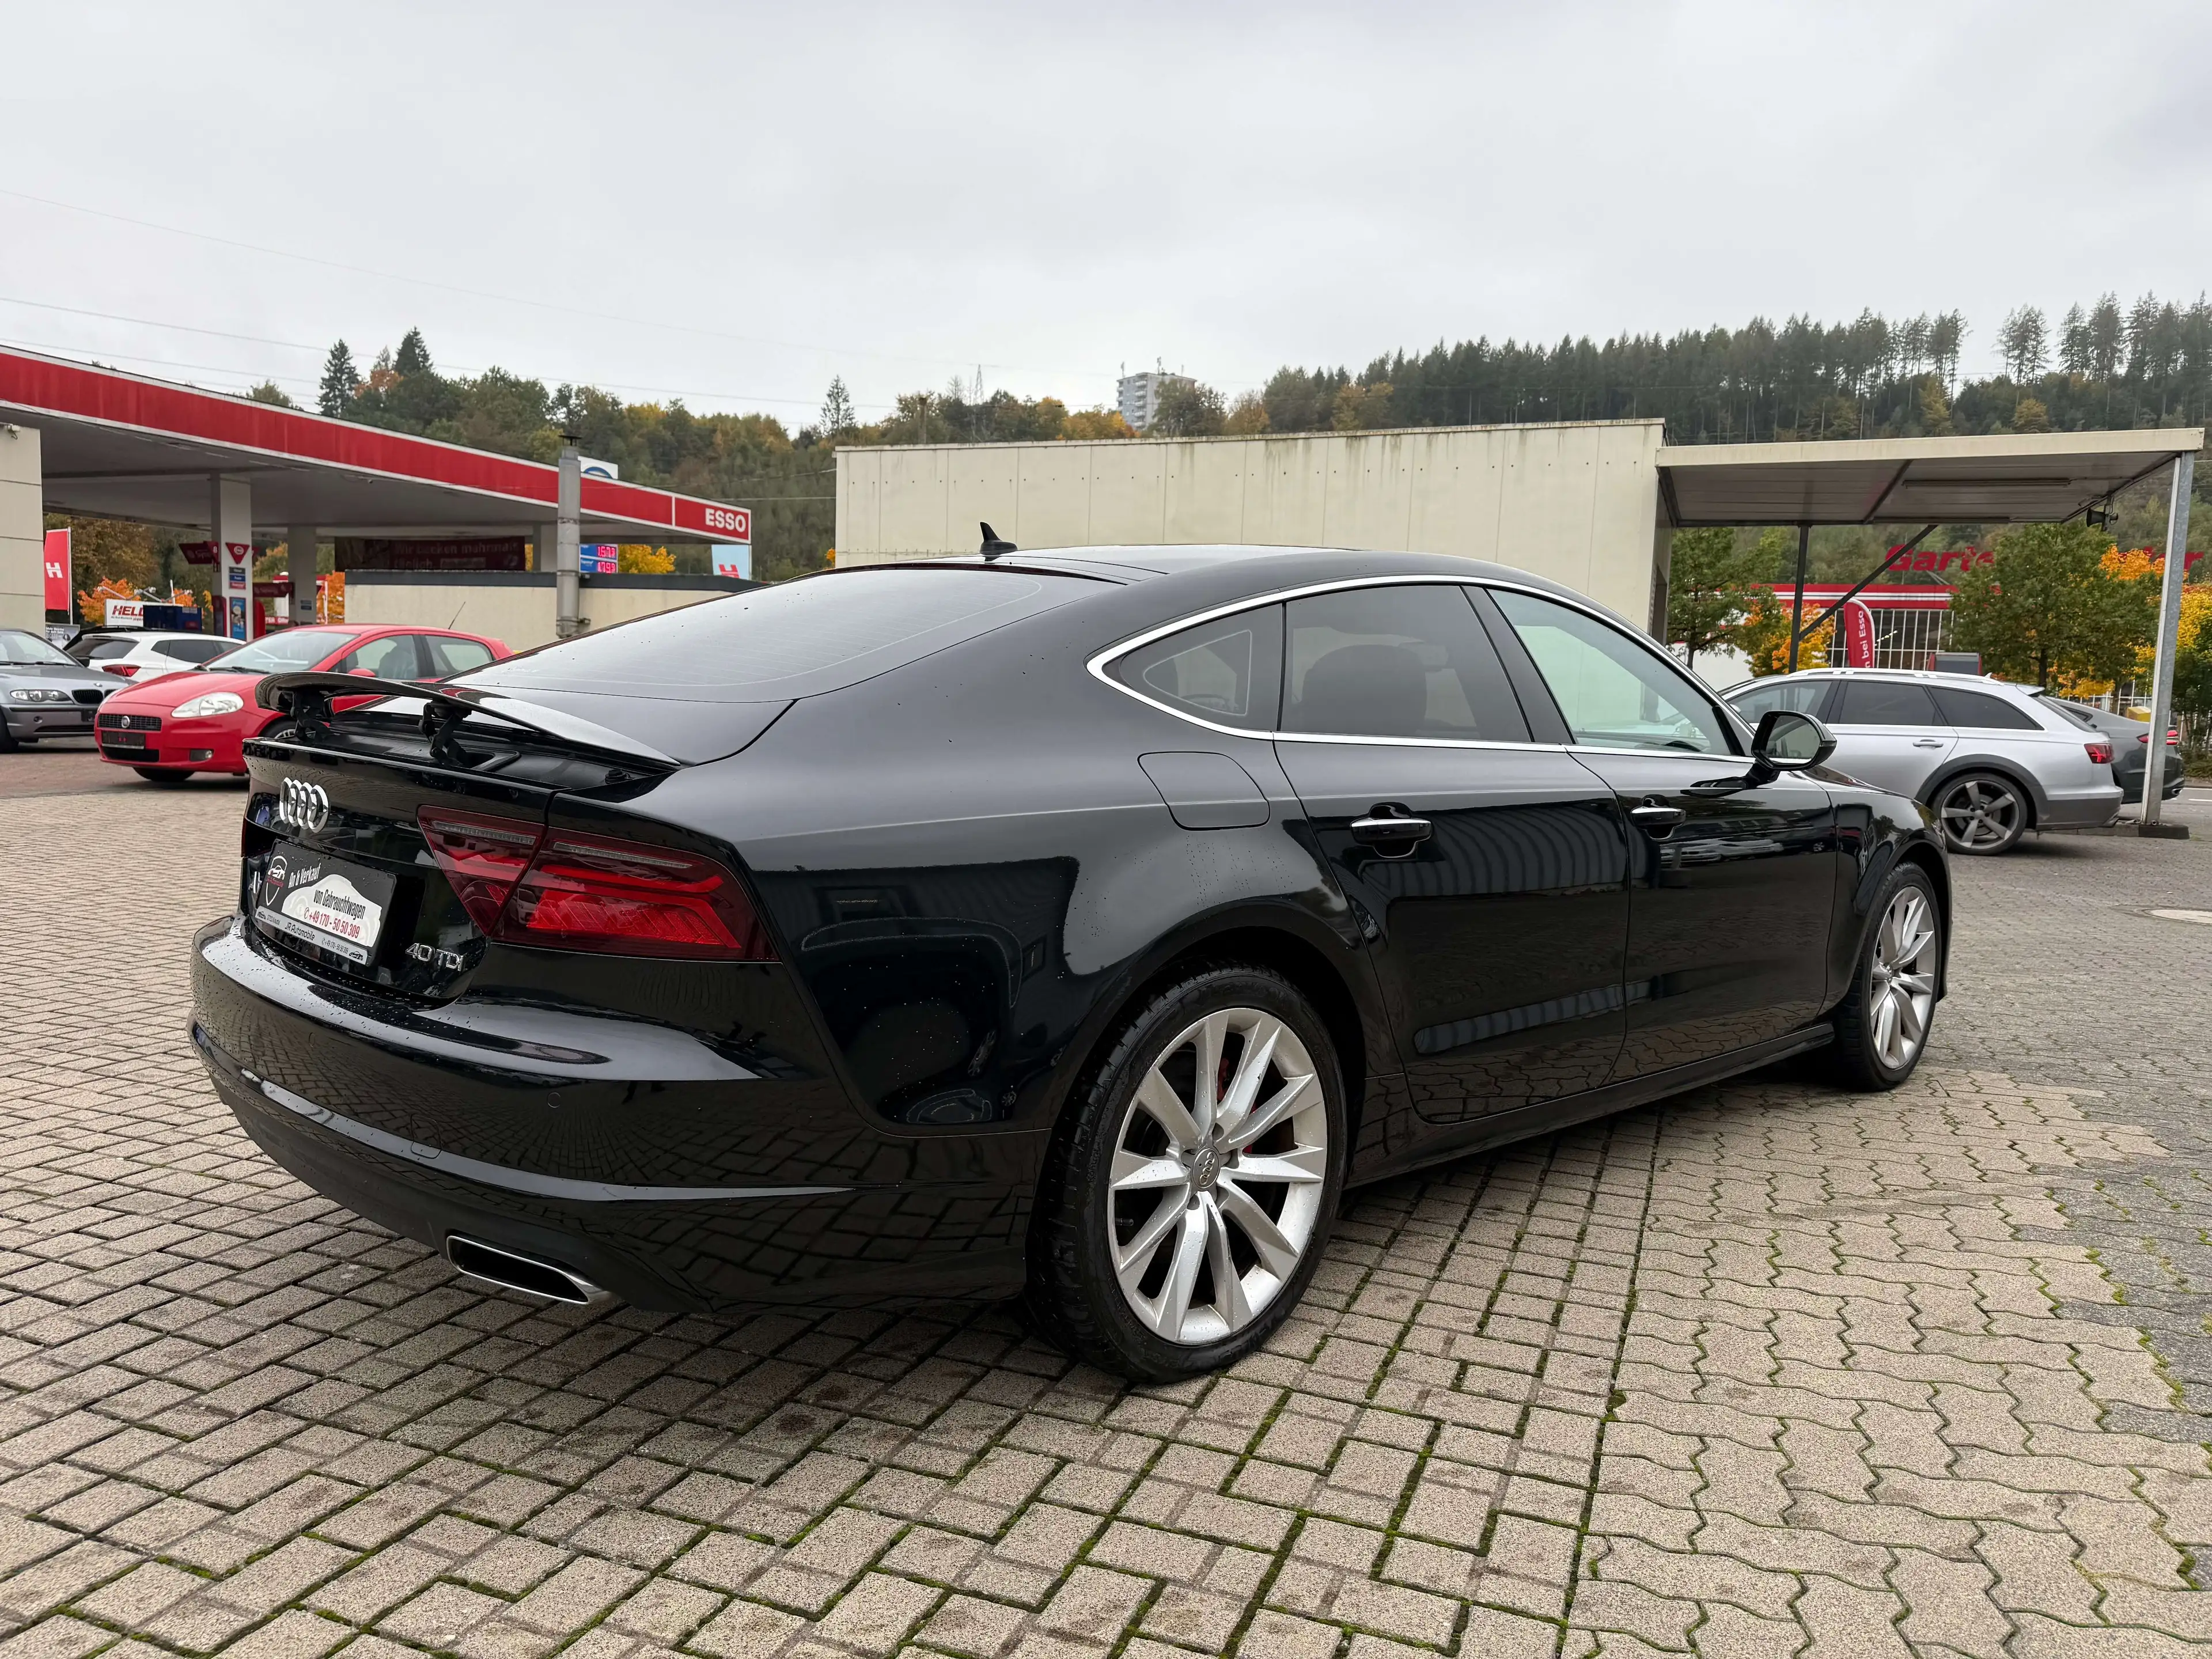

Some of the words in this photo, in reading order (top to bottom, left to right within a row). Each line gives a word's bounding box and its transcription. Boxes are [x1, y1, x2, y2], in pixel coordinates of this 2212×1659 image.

[705, 507, 746, 532] ESSO
[1858, 611, 1866, 637] Esso
[1859, 640, 1869, 659] bei
[288, 872, 296, 889] An
[301, 863, 321, 885] Verkauf
[313, 889, 322, 904] von
[322, 889, 366, 921] Gebrauchtwagen
[291, 925, 315, 941] Automobile
[320, 912, 329, 927] 170
[332, 918, 341, 932] 50
[341, 920, 349, 934] 50
[349, 923, 360, 938] 309
[405, 943, 433, 961] 40
[435, 949, 464, 971] TDI
